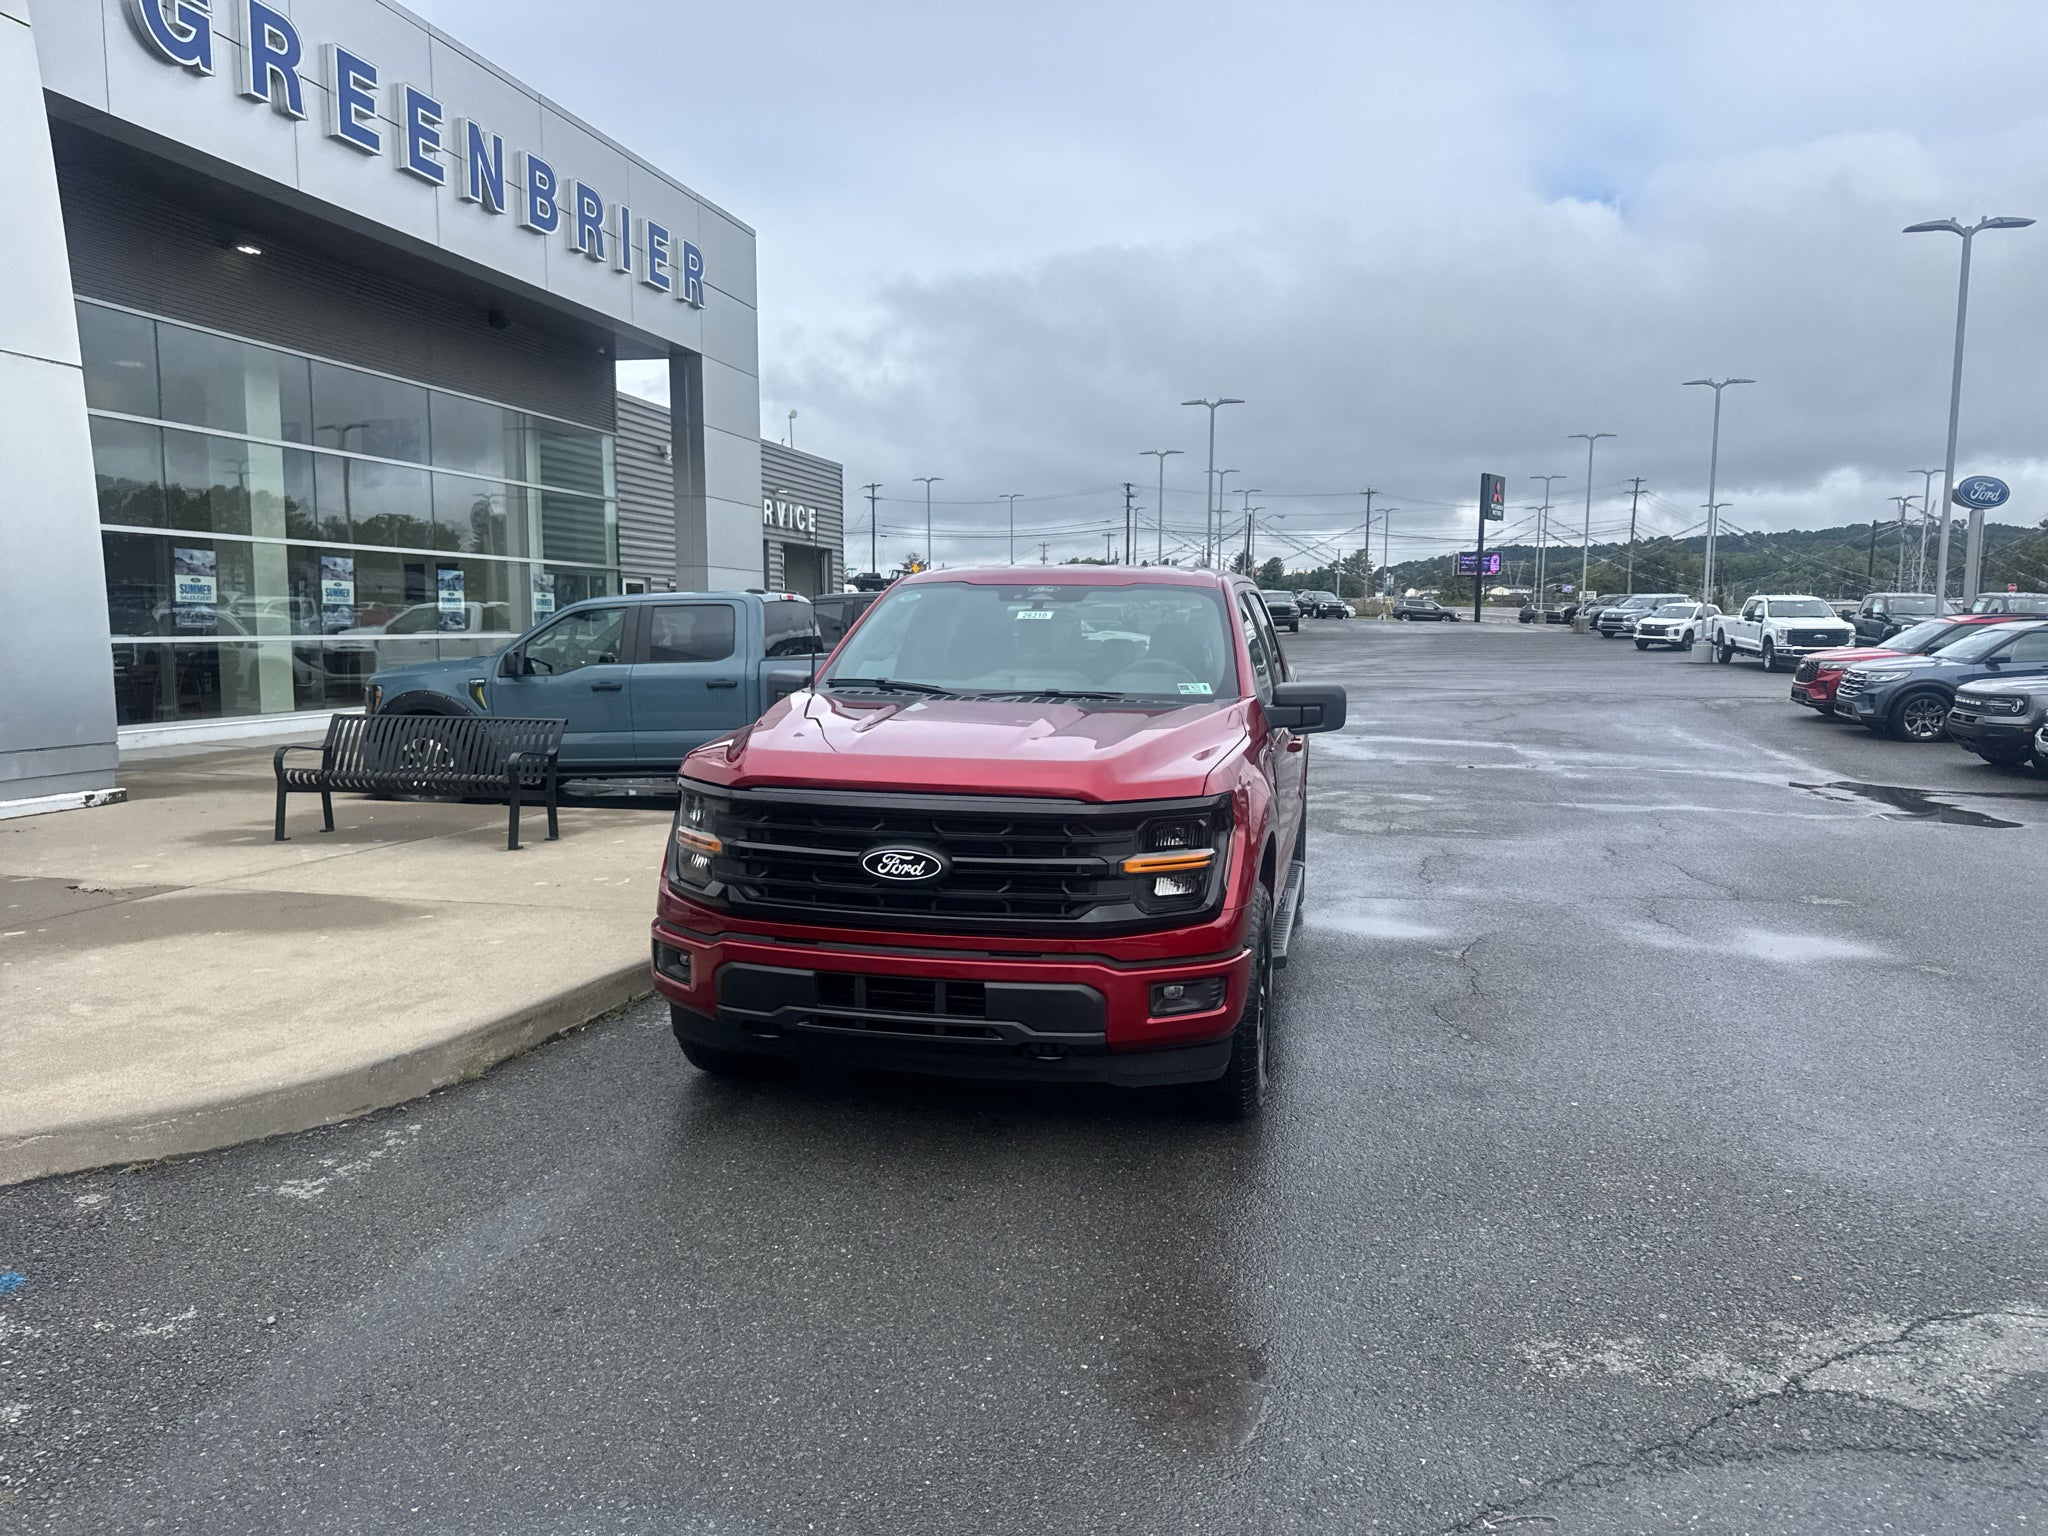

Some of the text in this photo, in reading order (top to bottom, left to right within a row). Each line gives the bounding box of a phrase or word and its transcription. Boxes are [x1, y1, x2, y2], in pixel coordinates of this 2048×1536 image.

[135, 0, 706, 308] GREENBRIER
[1970, 481, 2002, 502] Ford
[763, 498, 816, 533] RVICE
[179, 583, 212, 596] SUMMER
[325, 587, 350, 598] SUMMER
[1022, 612, 1048, 620] 26210
[877, 853, 926, 876] Ford
